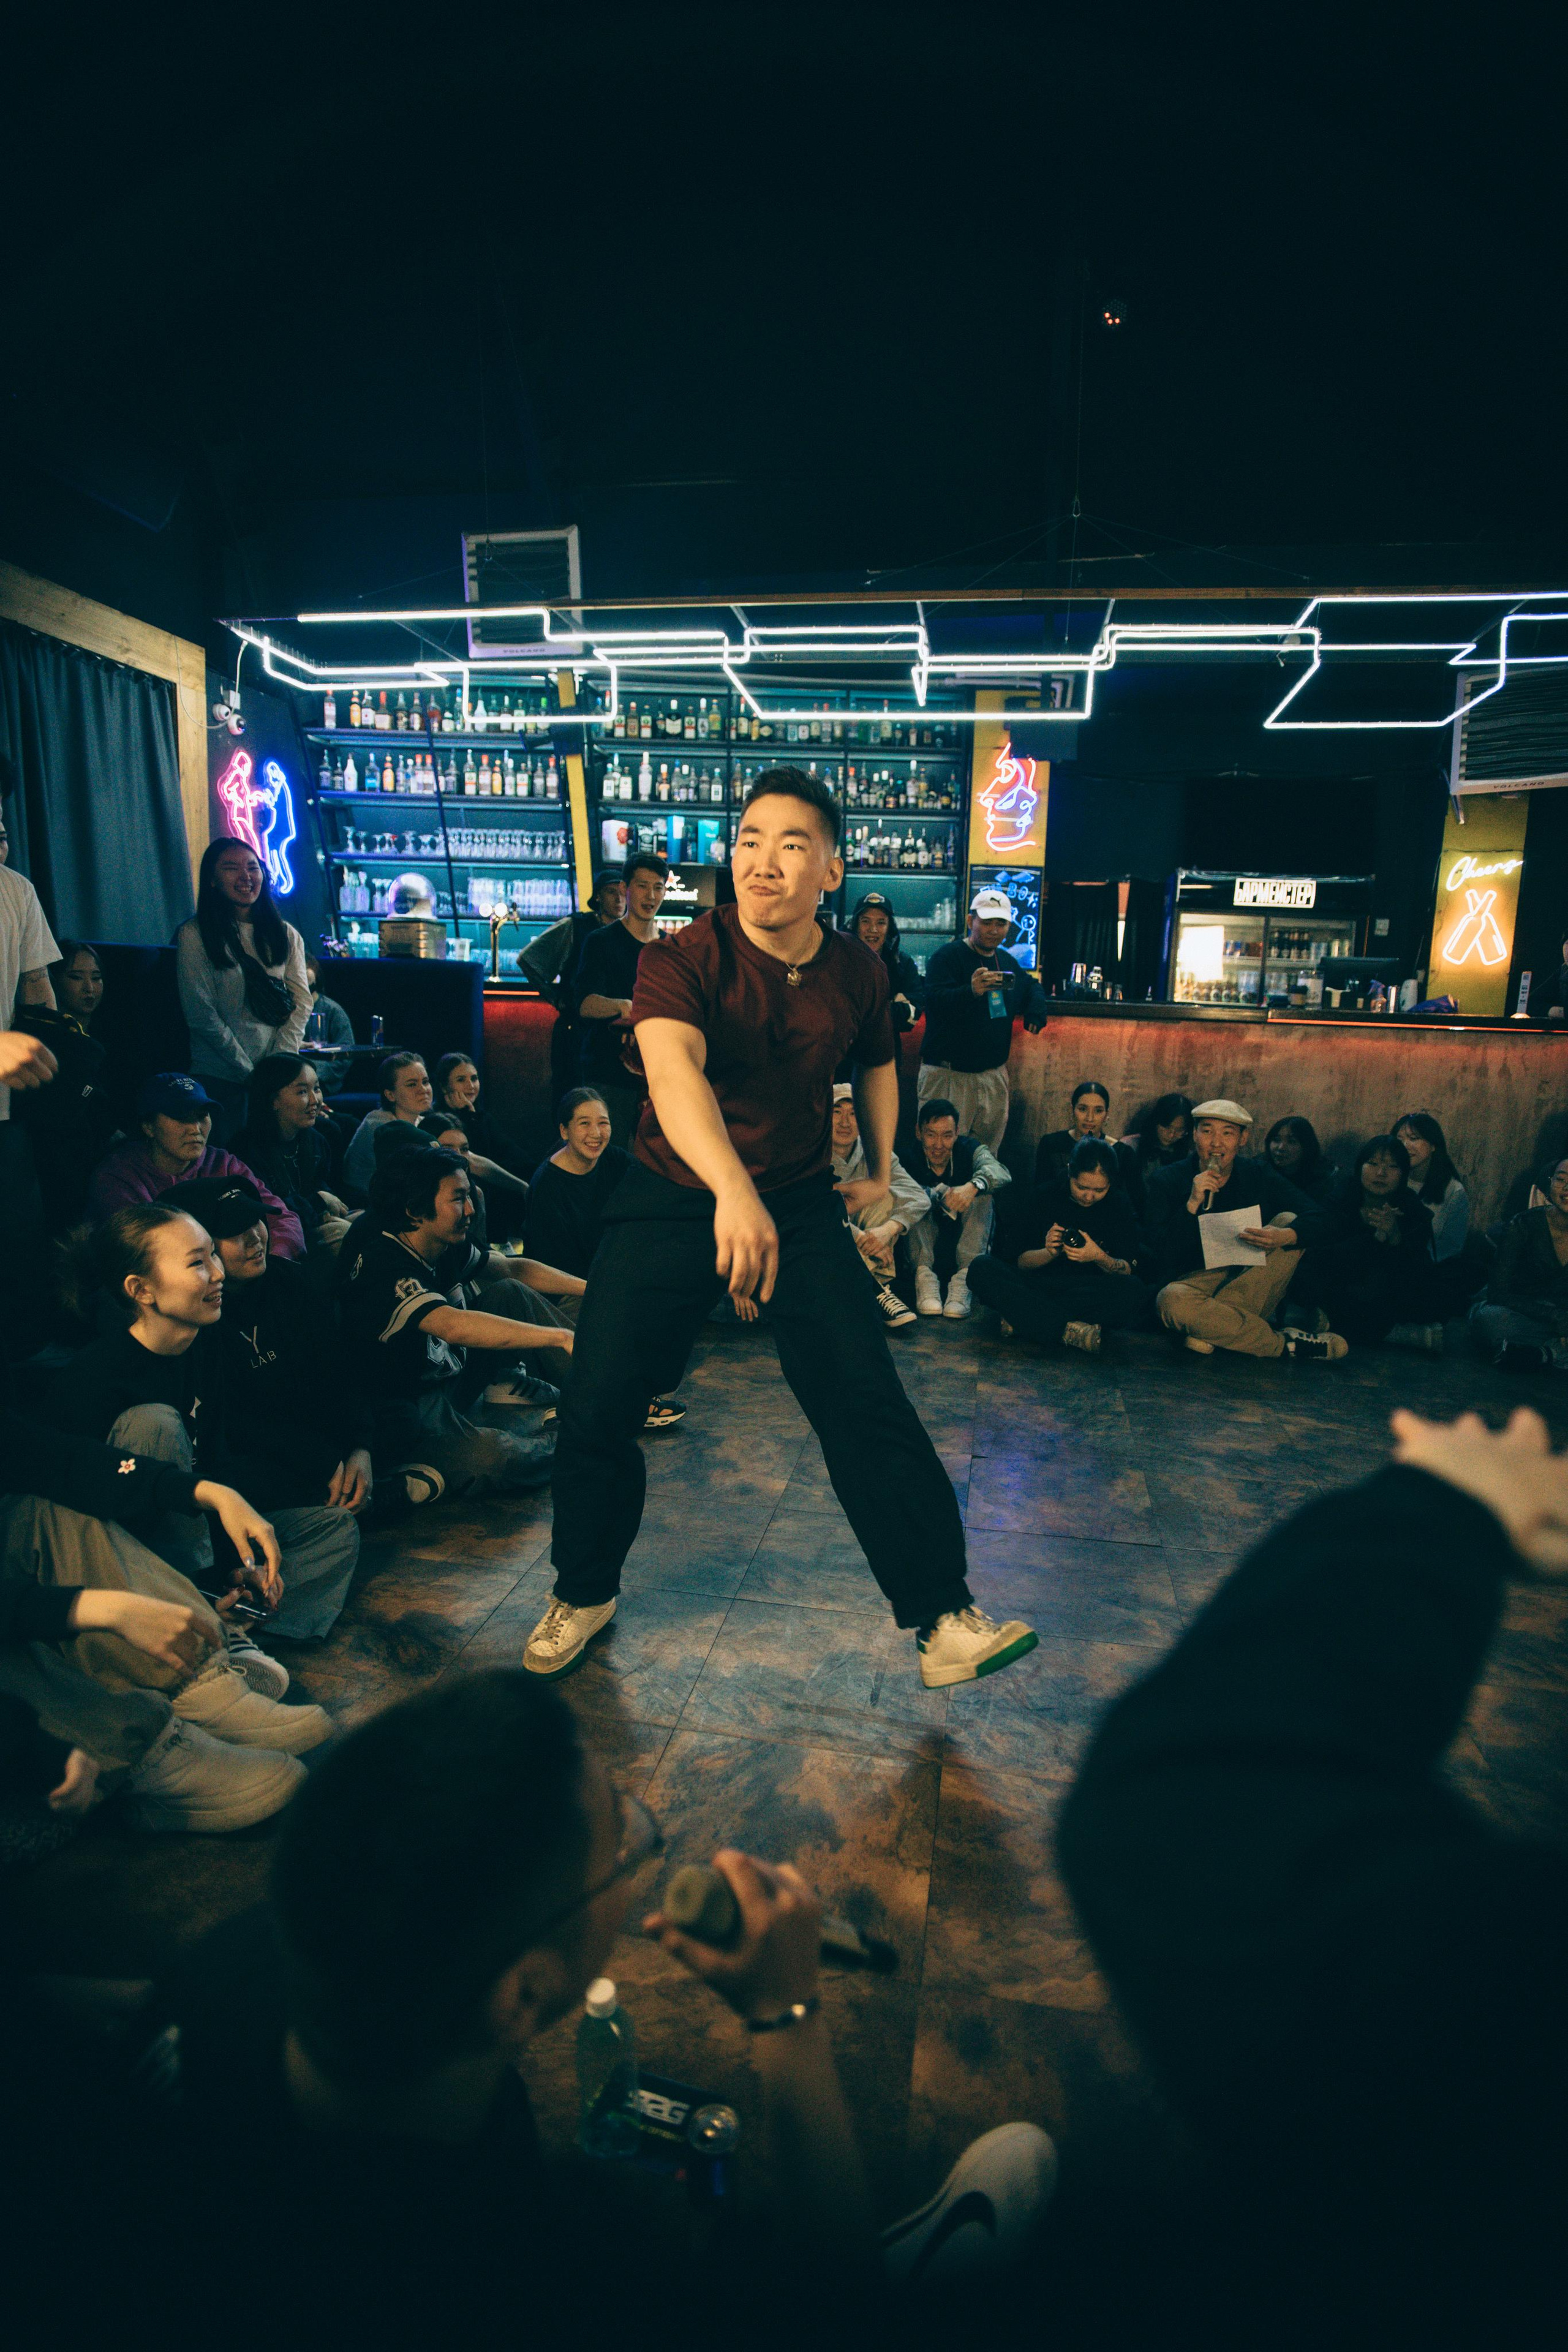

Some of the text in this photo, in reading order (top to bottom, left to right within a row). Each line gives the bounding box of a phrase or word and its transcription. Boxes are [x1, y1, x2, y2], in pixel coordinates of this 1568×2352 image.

[1446, 856, 1524, 891] Cheers
[239, 1325, 260, 1354] Y
[250, 1351, 276, 1368] LAB
